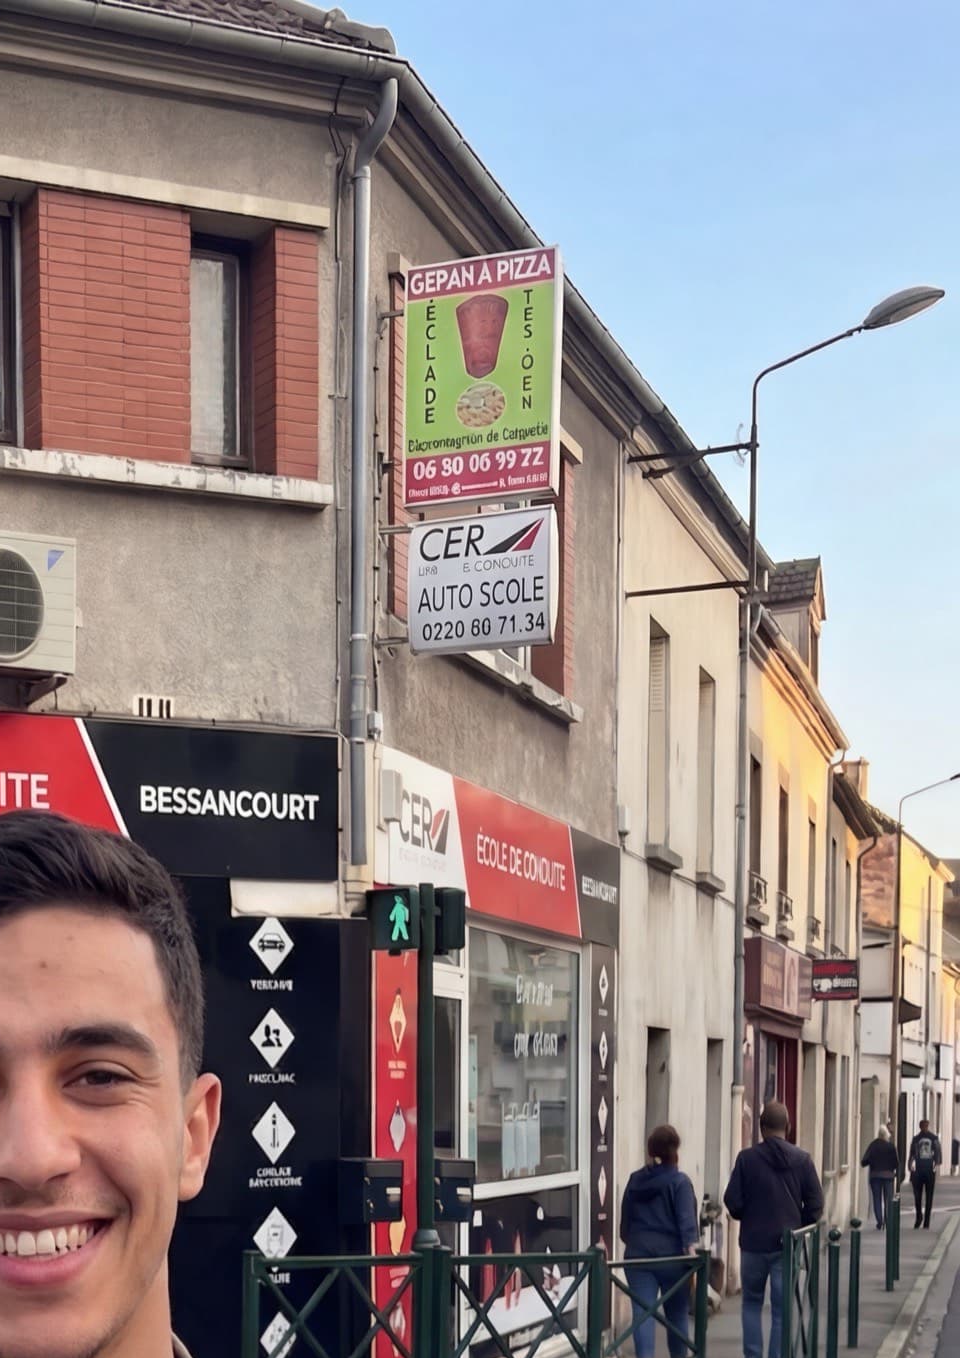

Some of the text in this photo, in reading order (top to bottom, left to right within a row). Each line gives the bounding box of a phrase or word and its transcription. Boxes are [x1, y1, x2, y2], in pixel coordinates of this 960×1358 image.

[410, 254, 551, 294] GEPAN A PIZZA
[487, 429, 499, 443] de
[413, 459, 436, 480] 06
[469, 453, 491, 473] 06
[495, 449, 517, 470] 99
[419, 524, 484, 561] CER
[418, 576, 544, 613] AUTO SCOLE
[422, 620, 465, 641] 0220
[139, 784, 320, 820] BESSANCOURT
[476, 827, 507, 872] ÉCOLE
[509, 847, 522, 877] DE
[523, 851, 566, 891] CONDUITE
